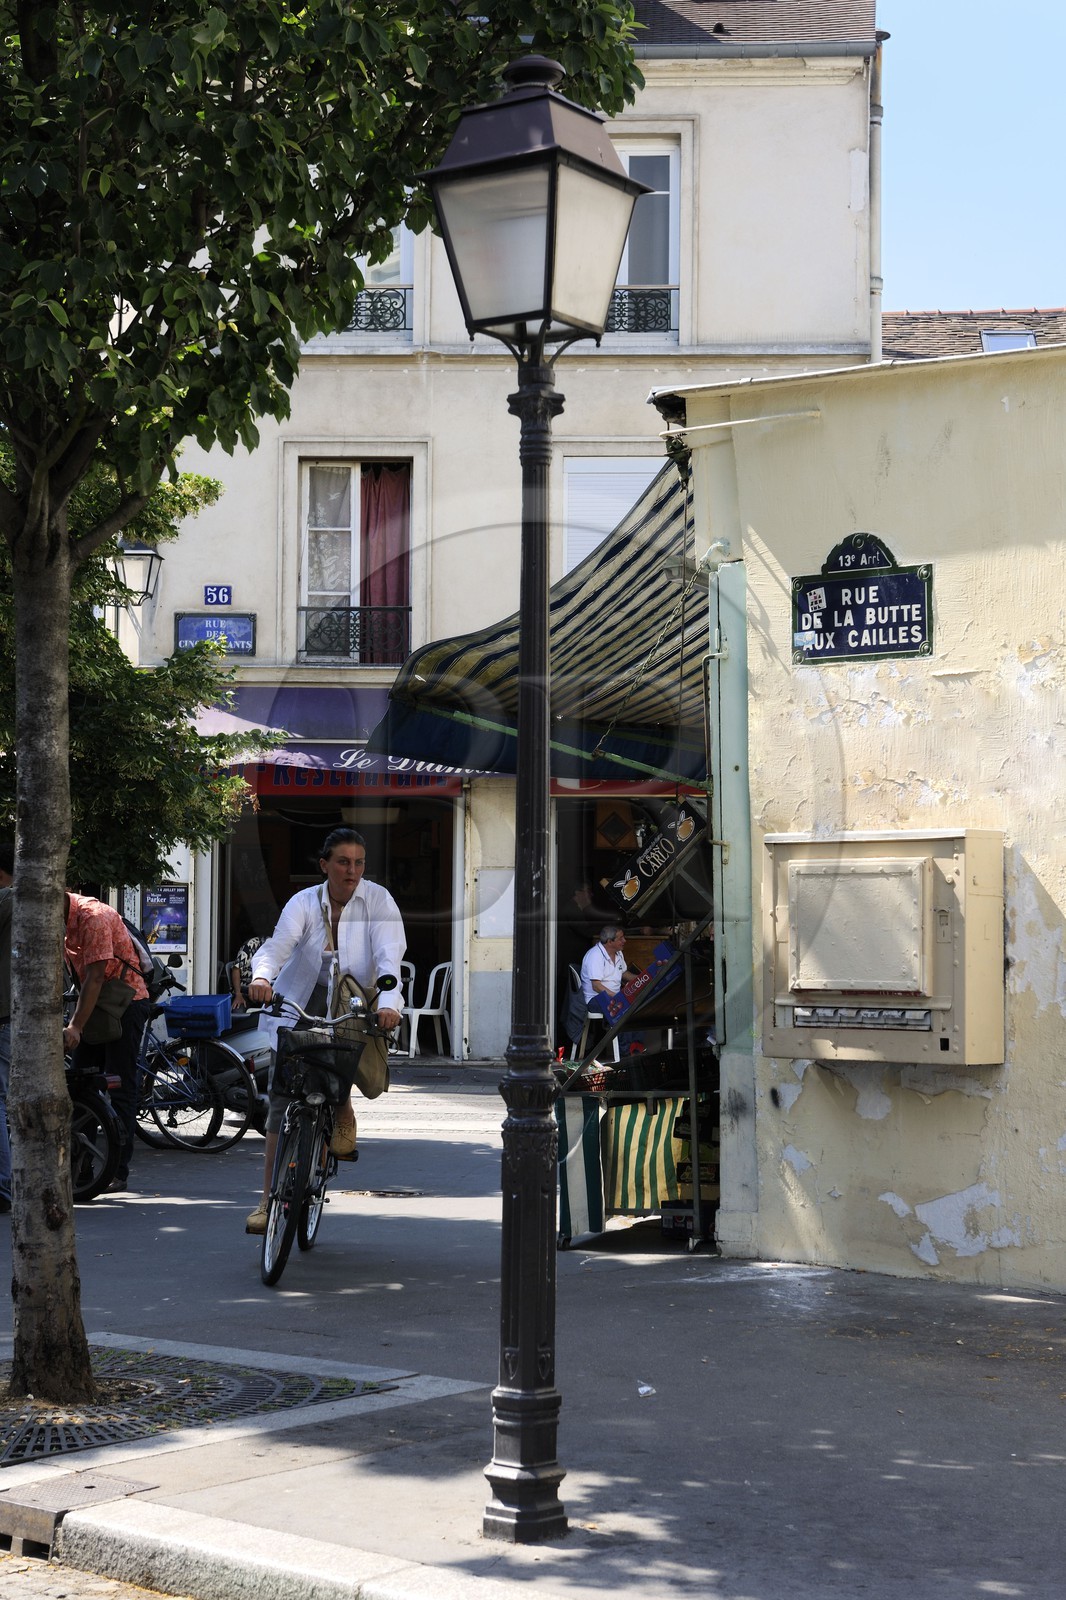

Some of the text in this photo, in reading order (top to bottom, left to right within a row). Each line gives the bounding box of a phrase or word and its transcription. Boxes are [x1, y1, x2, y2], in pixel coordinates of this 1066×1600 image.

[207, 587, 229, 604] 56
[841, 585, 879, 606] RUE
[205, 619, 227, 628] RUE
[801, 604, 922, 630] DE LA BUTTE
[206, 630, 225, 638] DES
[847, 625, 923, 648] CAILLES
[332, 748, 500, 774] Le Diam
[638, 837, 675, 878] CARLO
[645, 844, 661, 861] SAN
